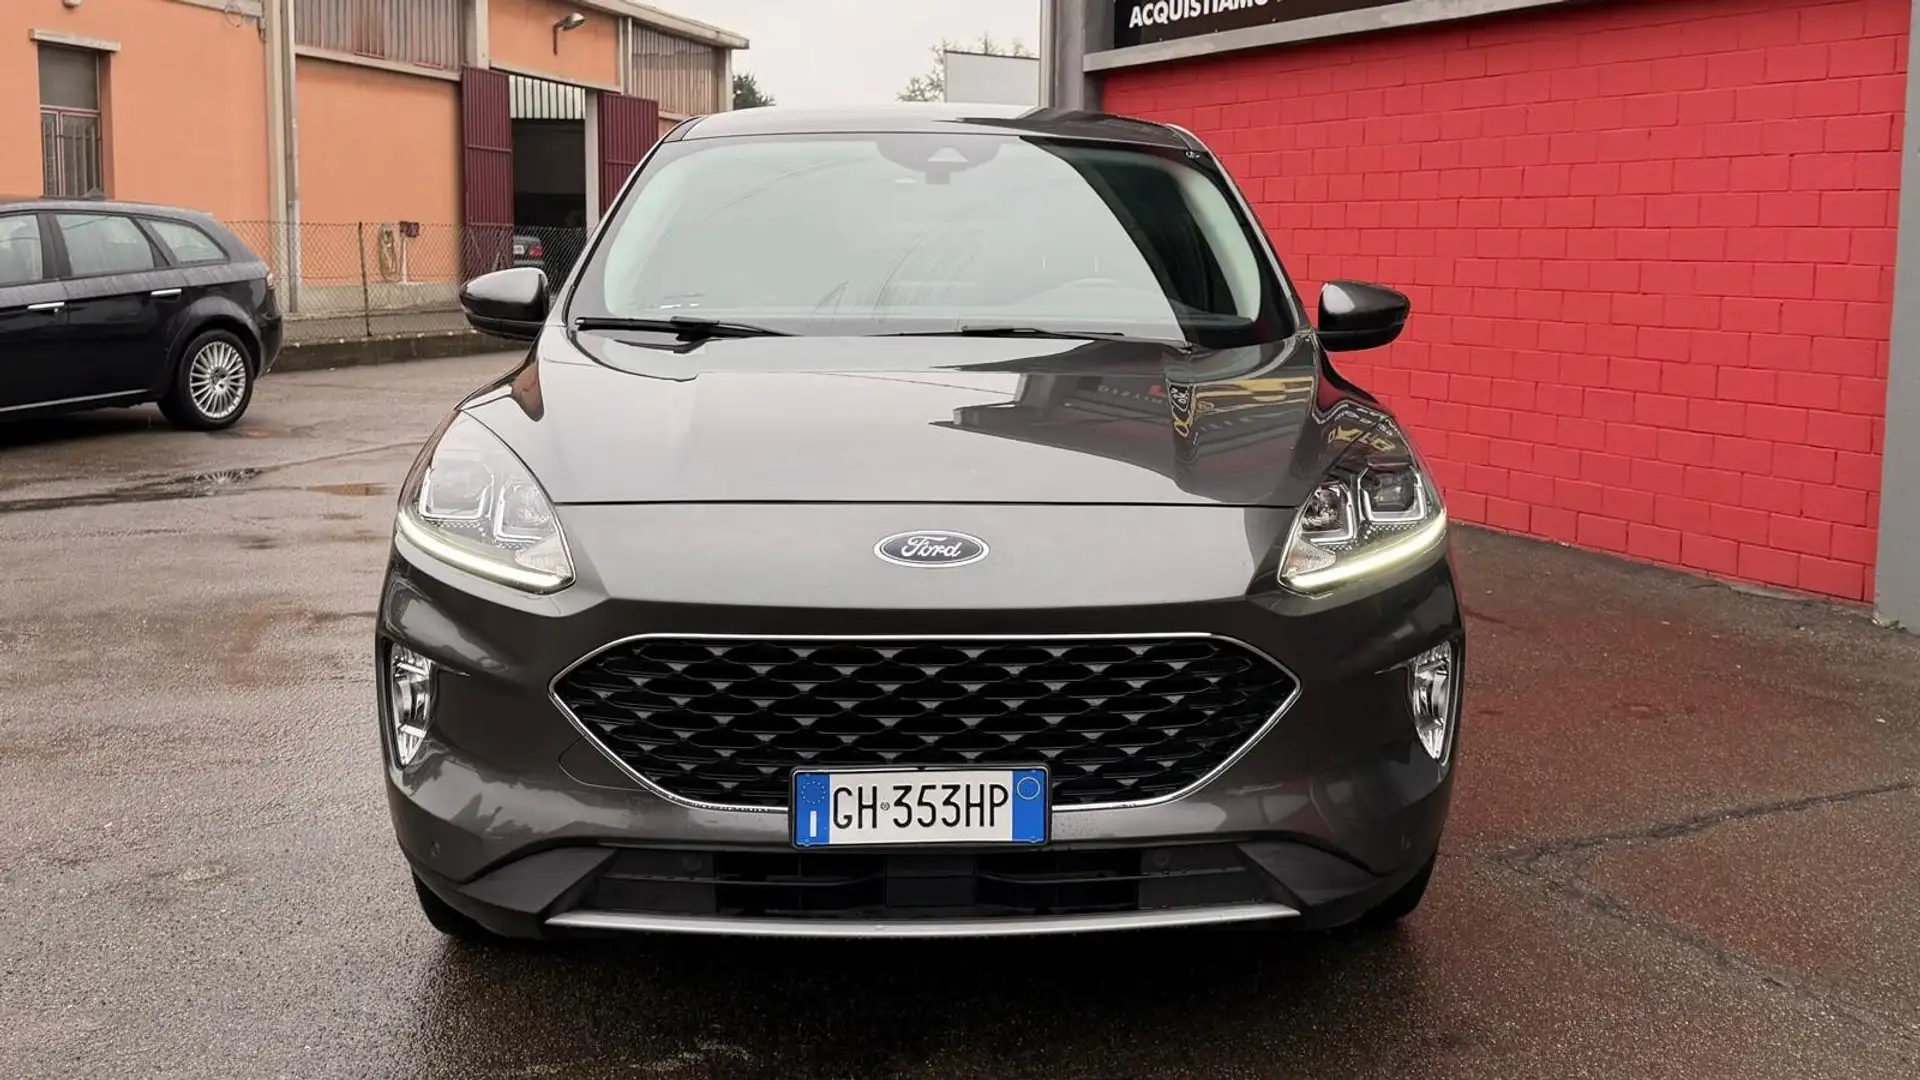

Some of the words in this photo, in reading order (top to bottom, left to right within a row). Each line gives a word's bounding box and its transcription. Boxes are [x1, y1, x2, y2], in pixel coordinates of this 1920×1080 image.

[1128, 0, 1268, 28] ACQUISTIA
[901, 535, 962, 558] Ford
[833, 785, 878, 829] GH
[892, 783, 1009, 828] 353HP
